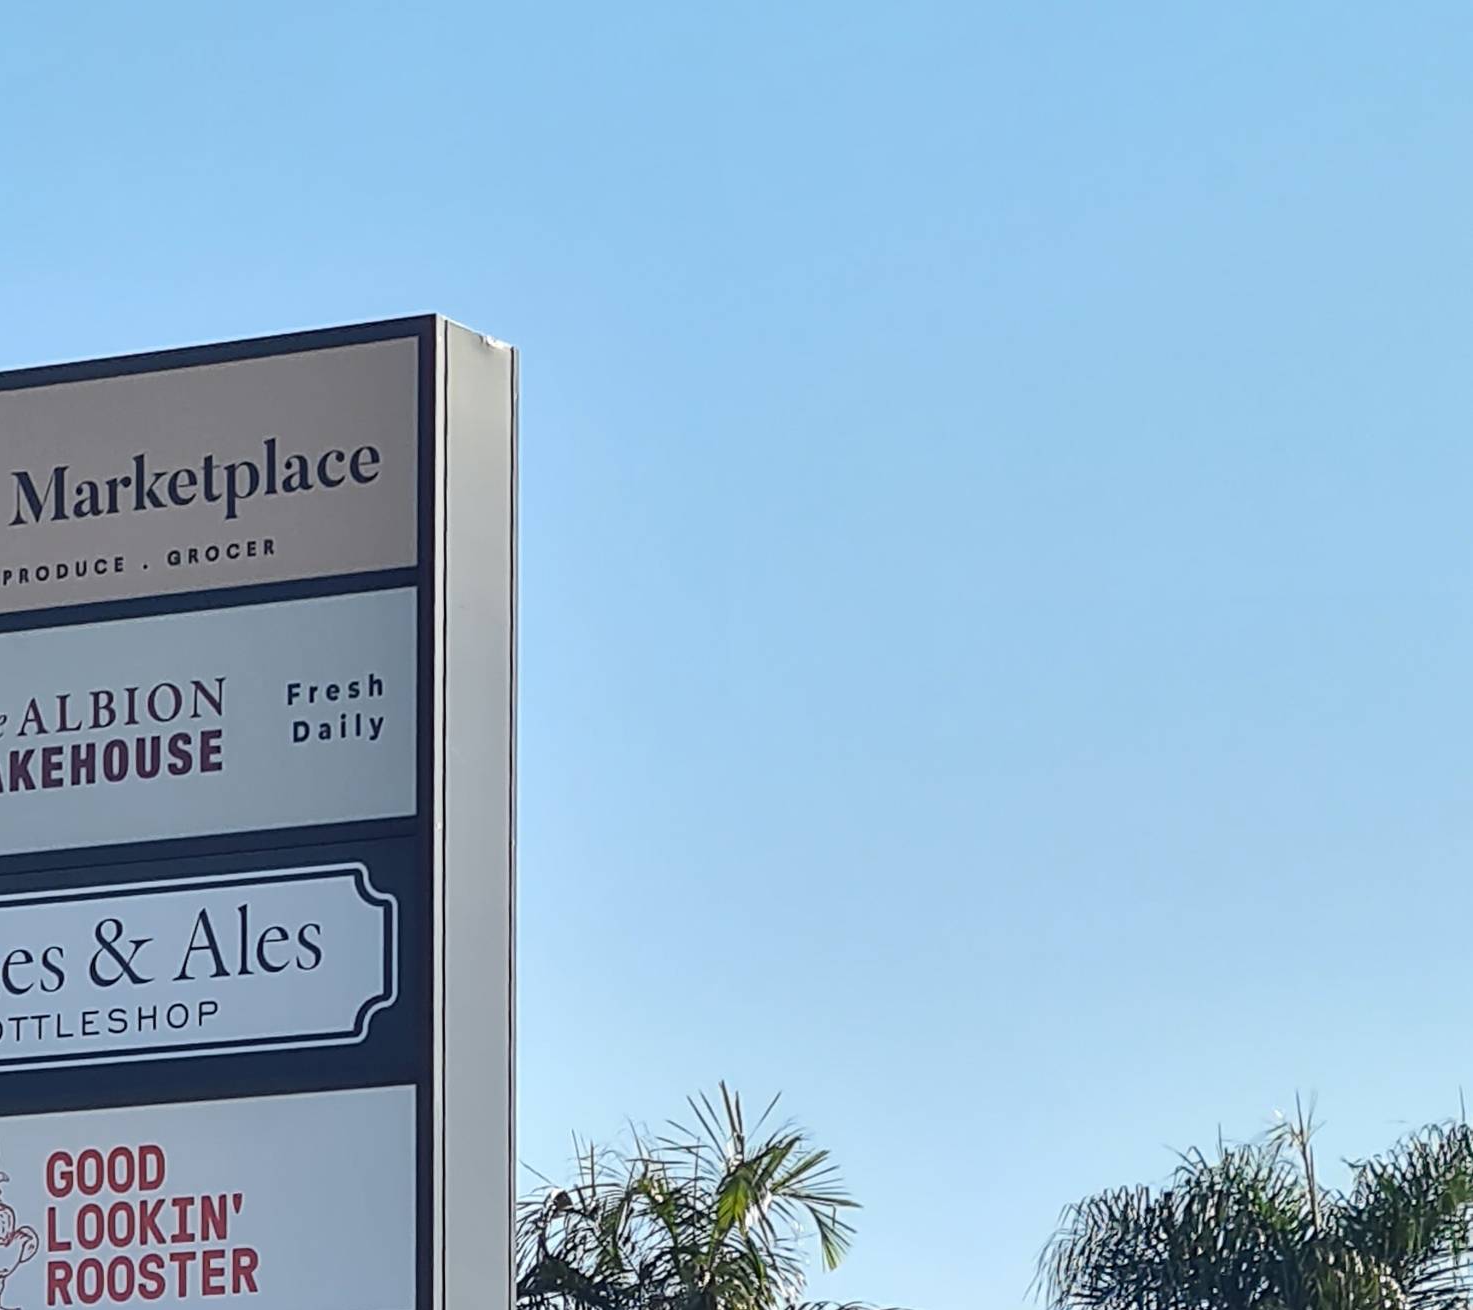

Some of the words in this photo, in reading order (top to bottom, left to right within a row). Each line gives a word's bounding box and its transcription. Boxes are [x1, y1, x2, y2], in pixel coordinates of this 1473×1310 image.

[9, 437, 381, 526] Marketplace
[2, 556, 124, 586] PRODUCE
[167, 538, 275, 567] GROCER
[17, 676, 226, 738] ALBION
[287, 673, 383, 706] Fresh
[293, 712, 384, 743] Daily
[89, 918, 154, 988] &
[173, 903, 323, 982] Ales
[46, 1144, 166, 1198] GOOD
[47, 1192, 243, 1252] LOOKIN'
[47, 1247, 259, 1307] ROOSTER
